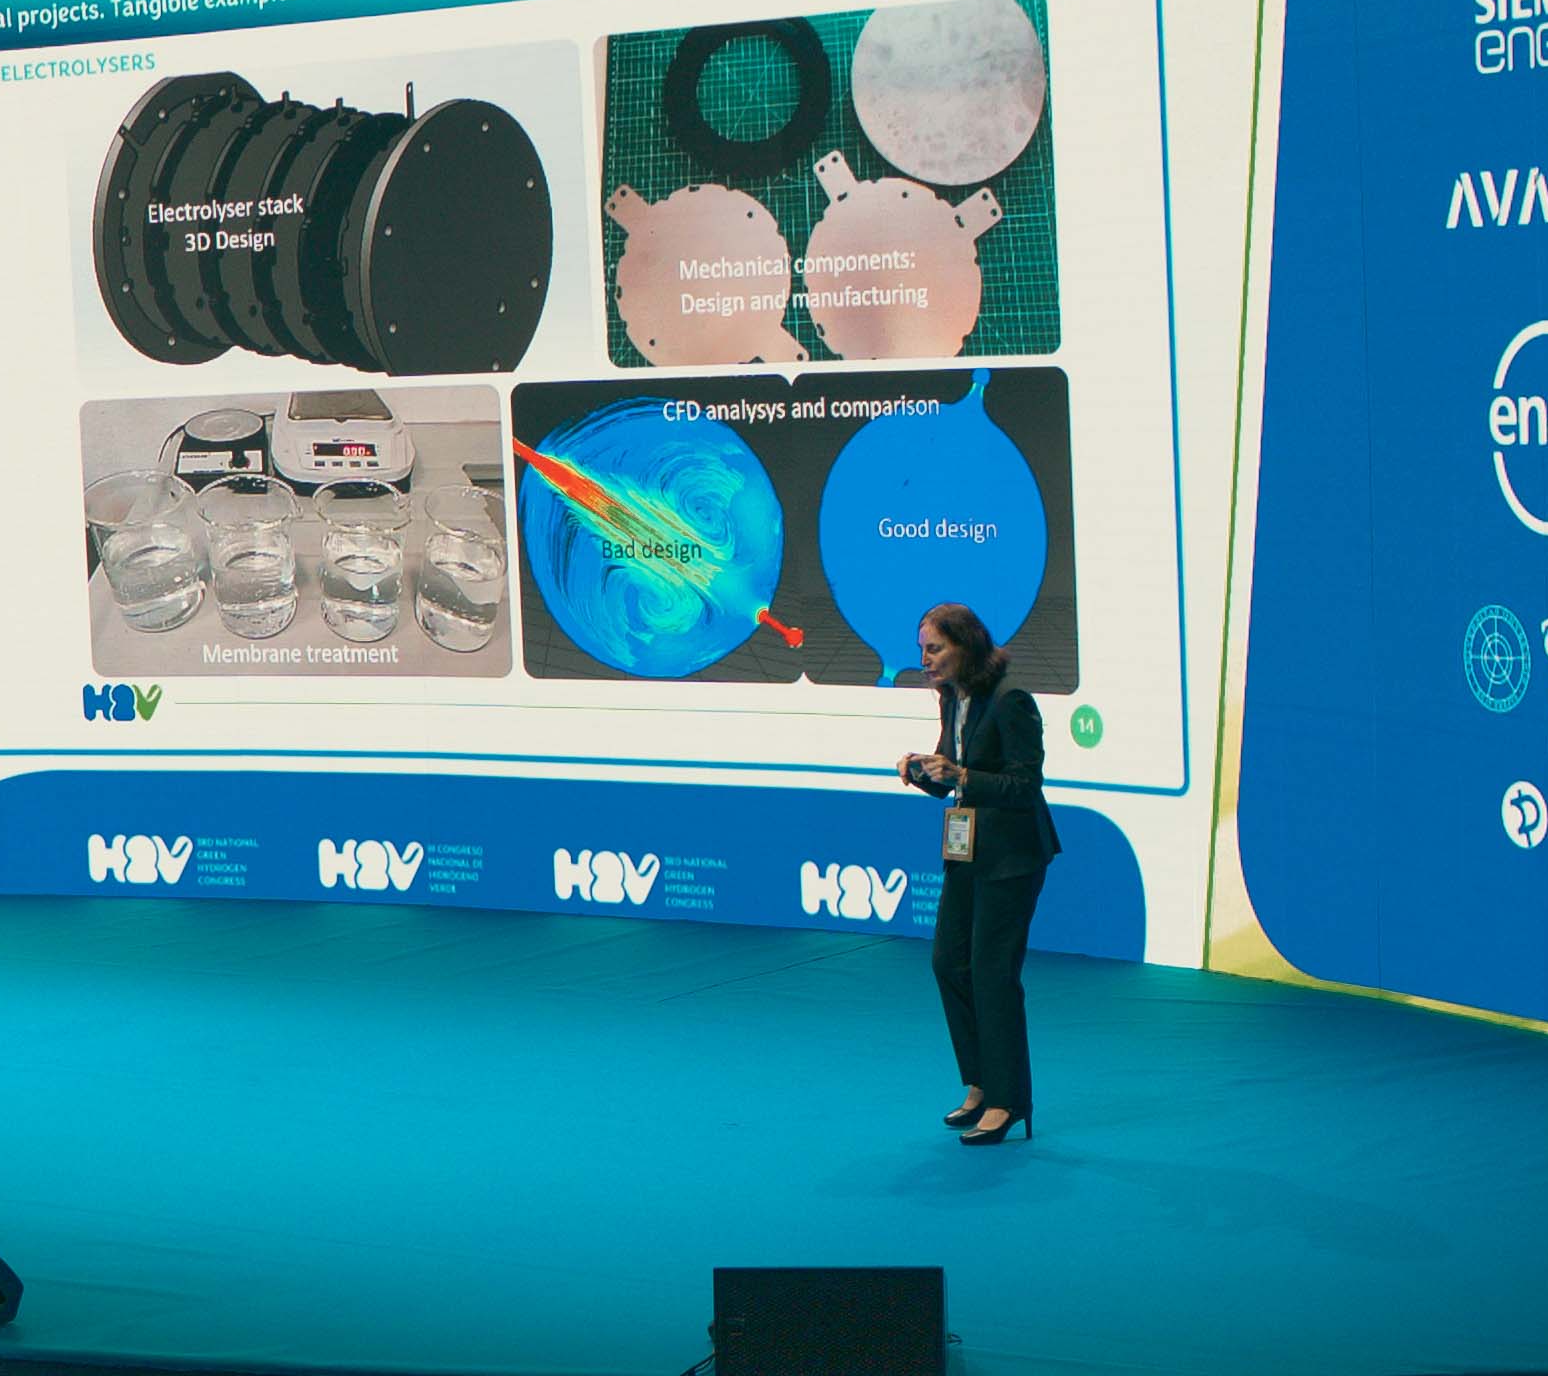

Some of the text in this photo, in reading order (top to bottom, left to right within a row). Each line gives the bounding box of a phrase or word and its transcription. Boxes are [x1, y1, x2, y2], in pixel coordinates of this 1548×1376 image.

[17, 1, 104, 32] projects.
[0, 53, 156, 83] ELECTROLYSERS
[148, 194, 304, 224] Electrolyser stack
[185, 228, 275, 253] 3D Design
[679, 249, 916, 281] Mechanical components:
[681, 282, 928, 316] Design and manufacturing
[663, 395, 940, 425] CFD analysys and comparison
[878, 518, 998, 544] Good design
[602, 538, 702, 563] Bad design
[202, 644, 399, 665] Membrane treatment
[1077, 717, 1095, 734] 14
